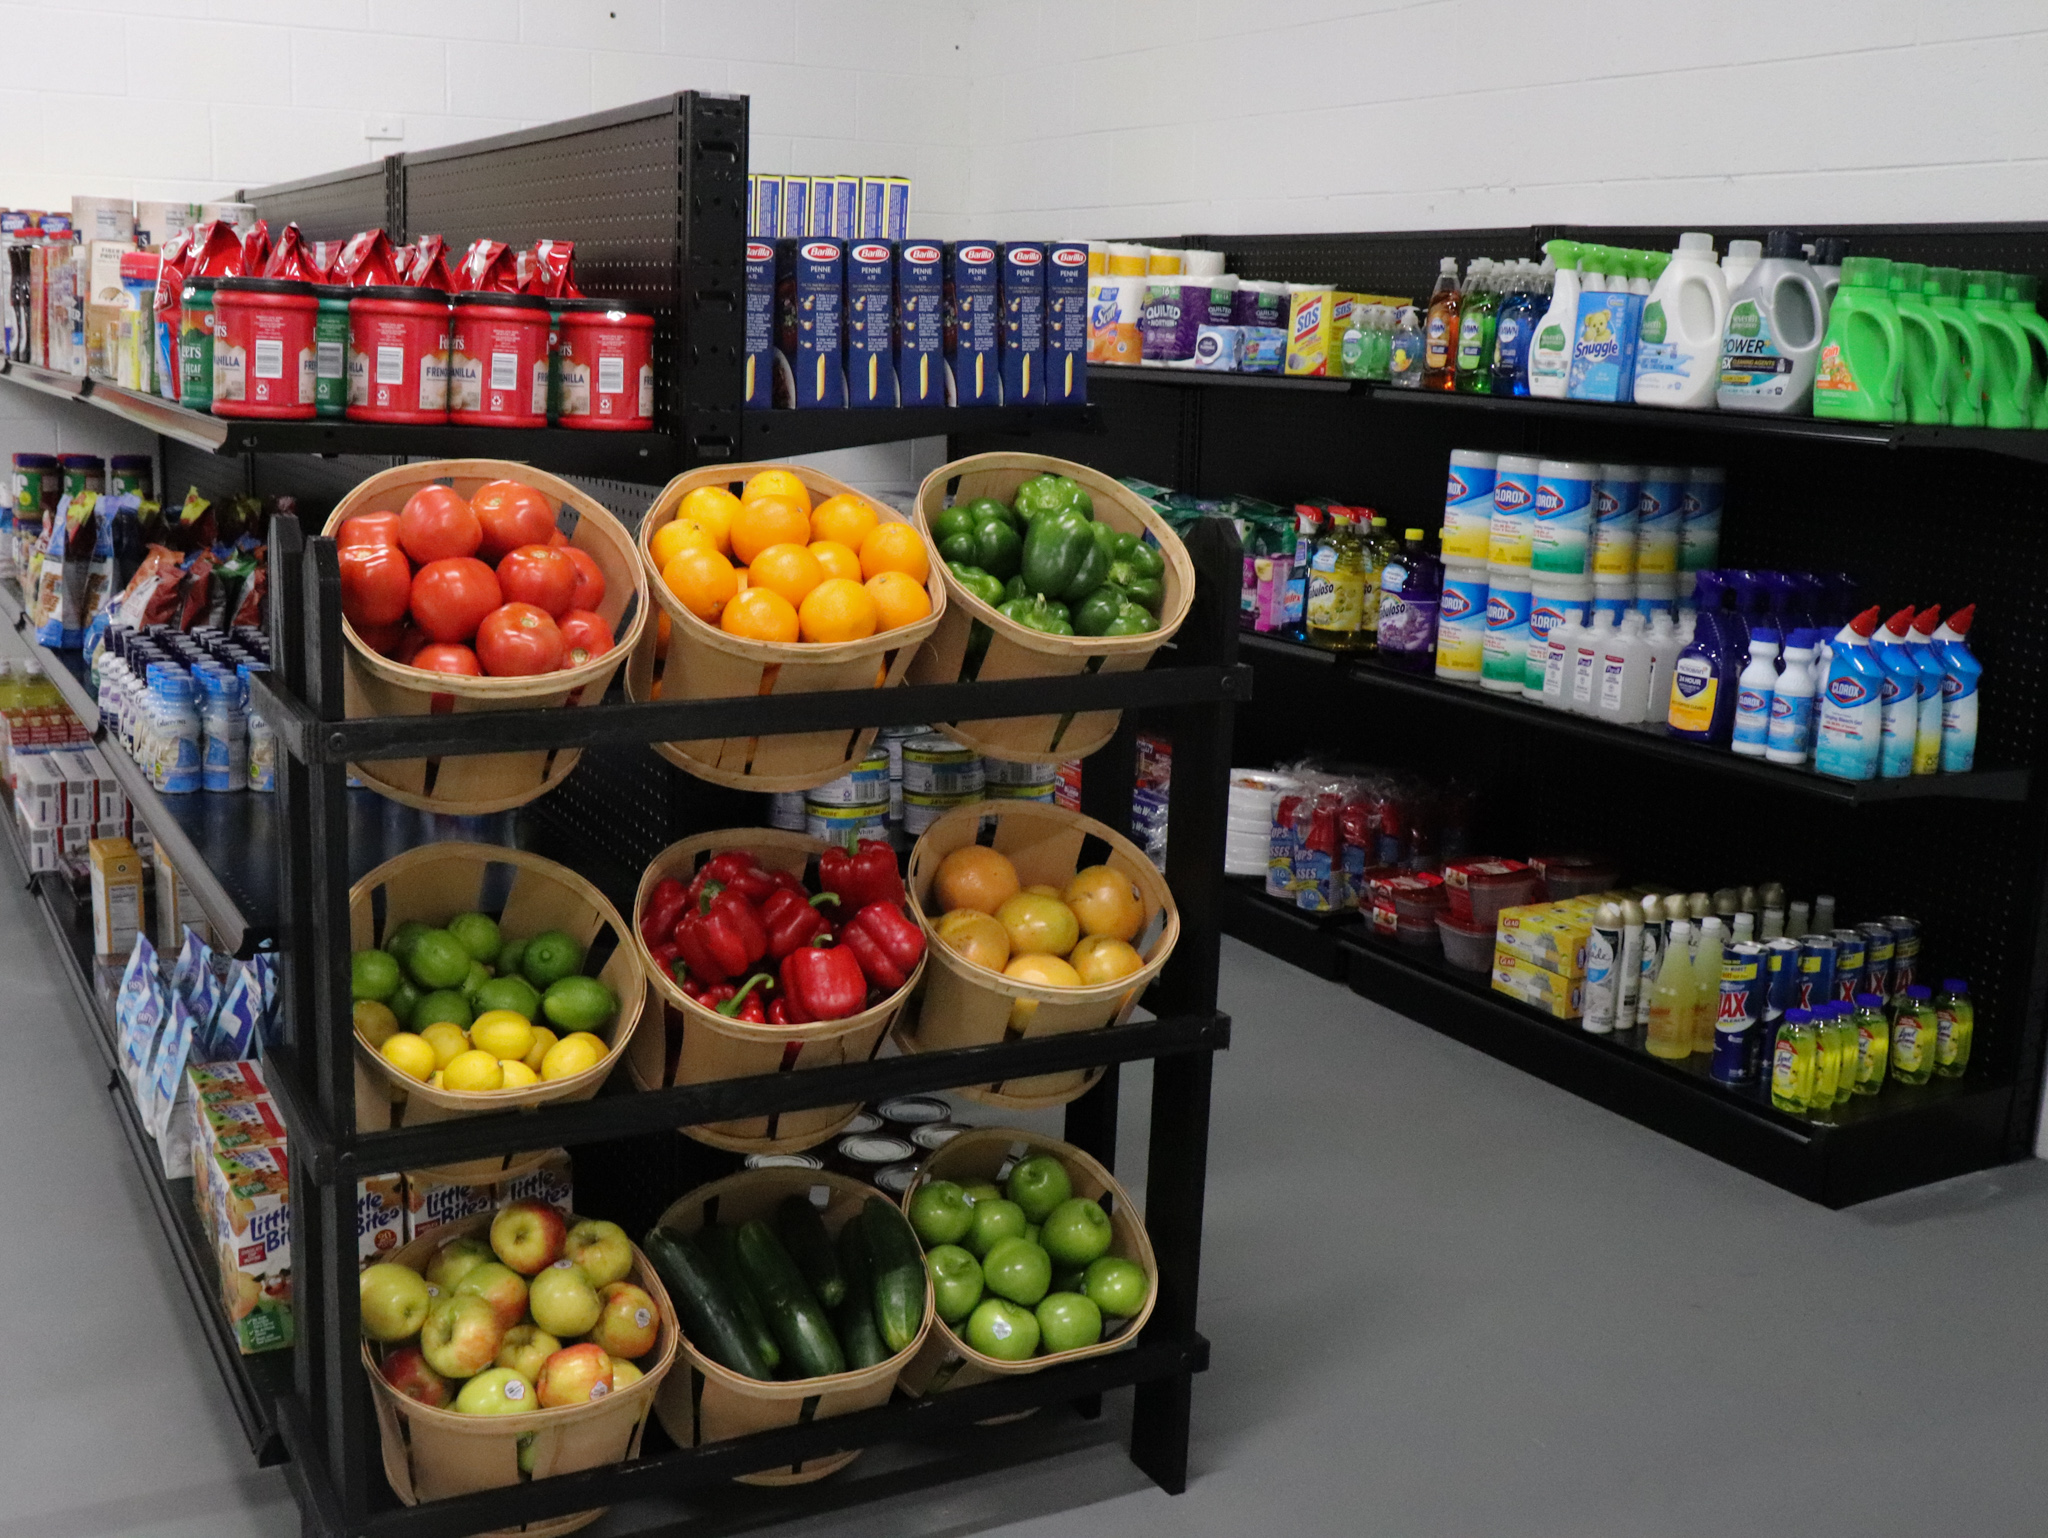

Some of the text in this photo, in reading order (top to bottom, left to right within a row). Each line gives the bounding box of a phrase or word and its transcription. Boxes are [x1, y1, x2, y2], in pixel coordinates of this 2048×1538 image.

[810, 246, 837, 258] Barilla
[861, 248, 887, 258] Barilla
[913, 250, 938, 260] Barilla
[967, 250, 992, 260] Barilla
[1016, 252, 1040, 262] Barilla
[1060, 253, 1085, 263] Barilla
[1162, 286, 1170, 296] 16
[1094, 302, 1119, 327] Scott
[1146, 304, 1181, 321] QUILTED
[1208, 306, 1232, 316] QUILTED
[1335, 302, 1352, 317] SOS
[1296, 306, 1320, 334] SOS
[1575, 339, 1618, 358] Snuggle
[213, 355, 240, 368] ANILLA
[451, 368, 476, 379] ANILLA
[1495, 490, 1525, 504] CLOROX
[1684, 676, 1702, 686] HOUR
[1832, 682, 1860, 698] CLOROX
[1271, 827, 1289, 838] UPS
[1503, 917, 1520, 928] GLAD
[1500, 956, 1515, 966] GLAD
[1590, 950, 1609, 962] ade
[510, 1170, 554, 1200] Little
[426, 1185, 471, 1218] Little
[378, 1230, 391, 1240] 20
